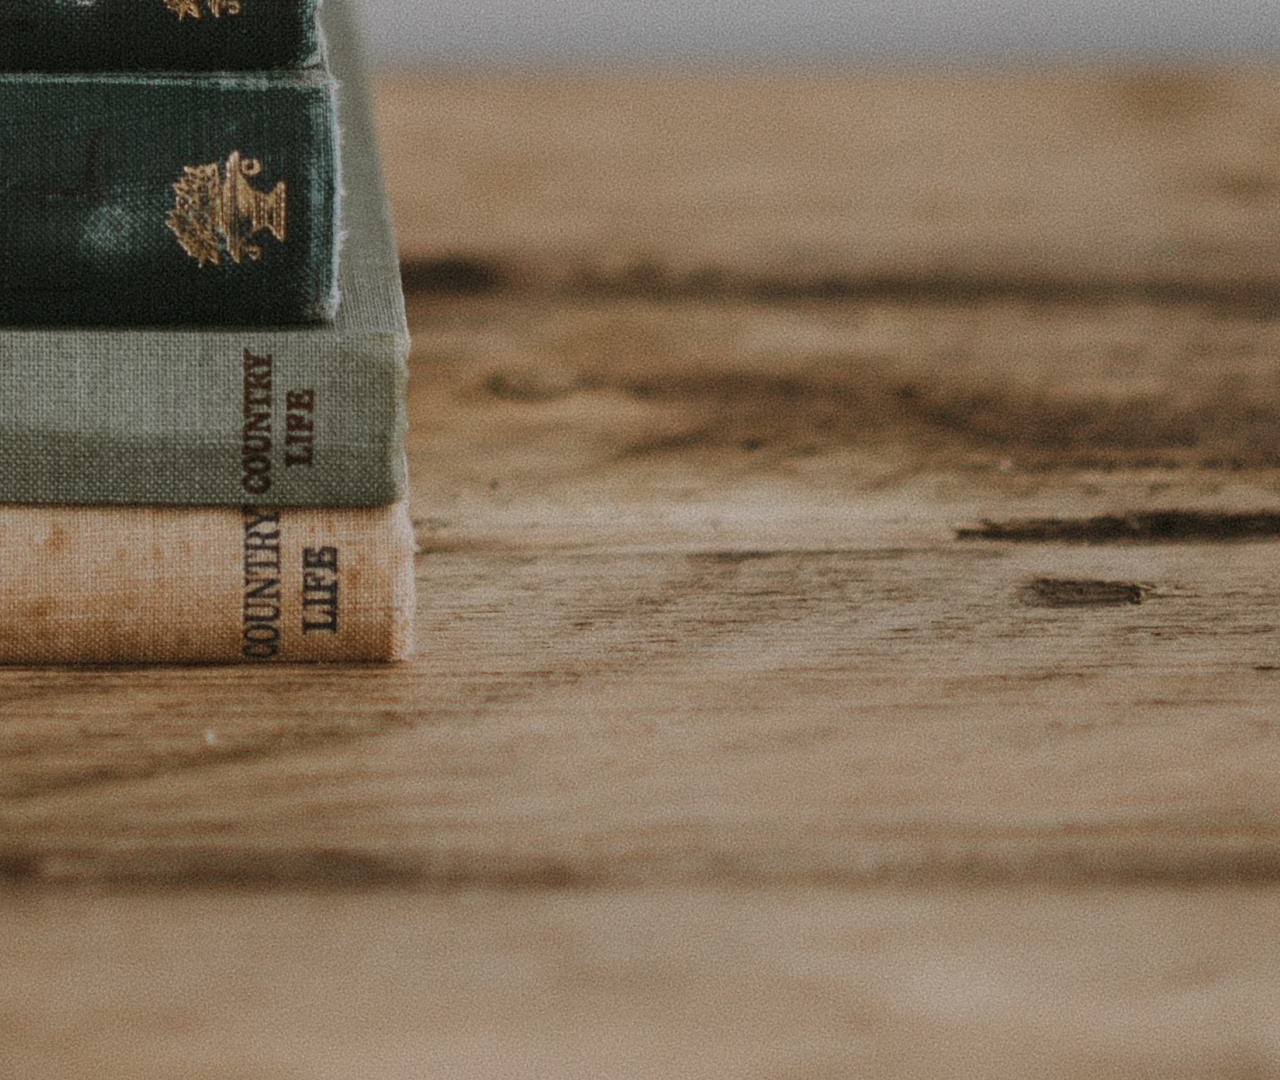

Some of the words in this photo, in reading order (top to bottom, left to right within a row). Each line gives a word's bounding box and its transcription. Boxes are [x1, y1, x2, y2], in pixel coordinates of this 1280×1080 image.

[243, 348, 272, 495] COUNTRY
[285, 389, 314, 467] LIFE
[242, 505, 280, 659] COUNTRY
[302, 546, 337, 634] LIFE
